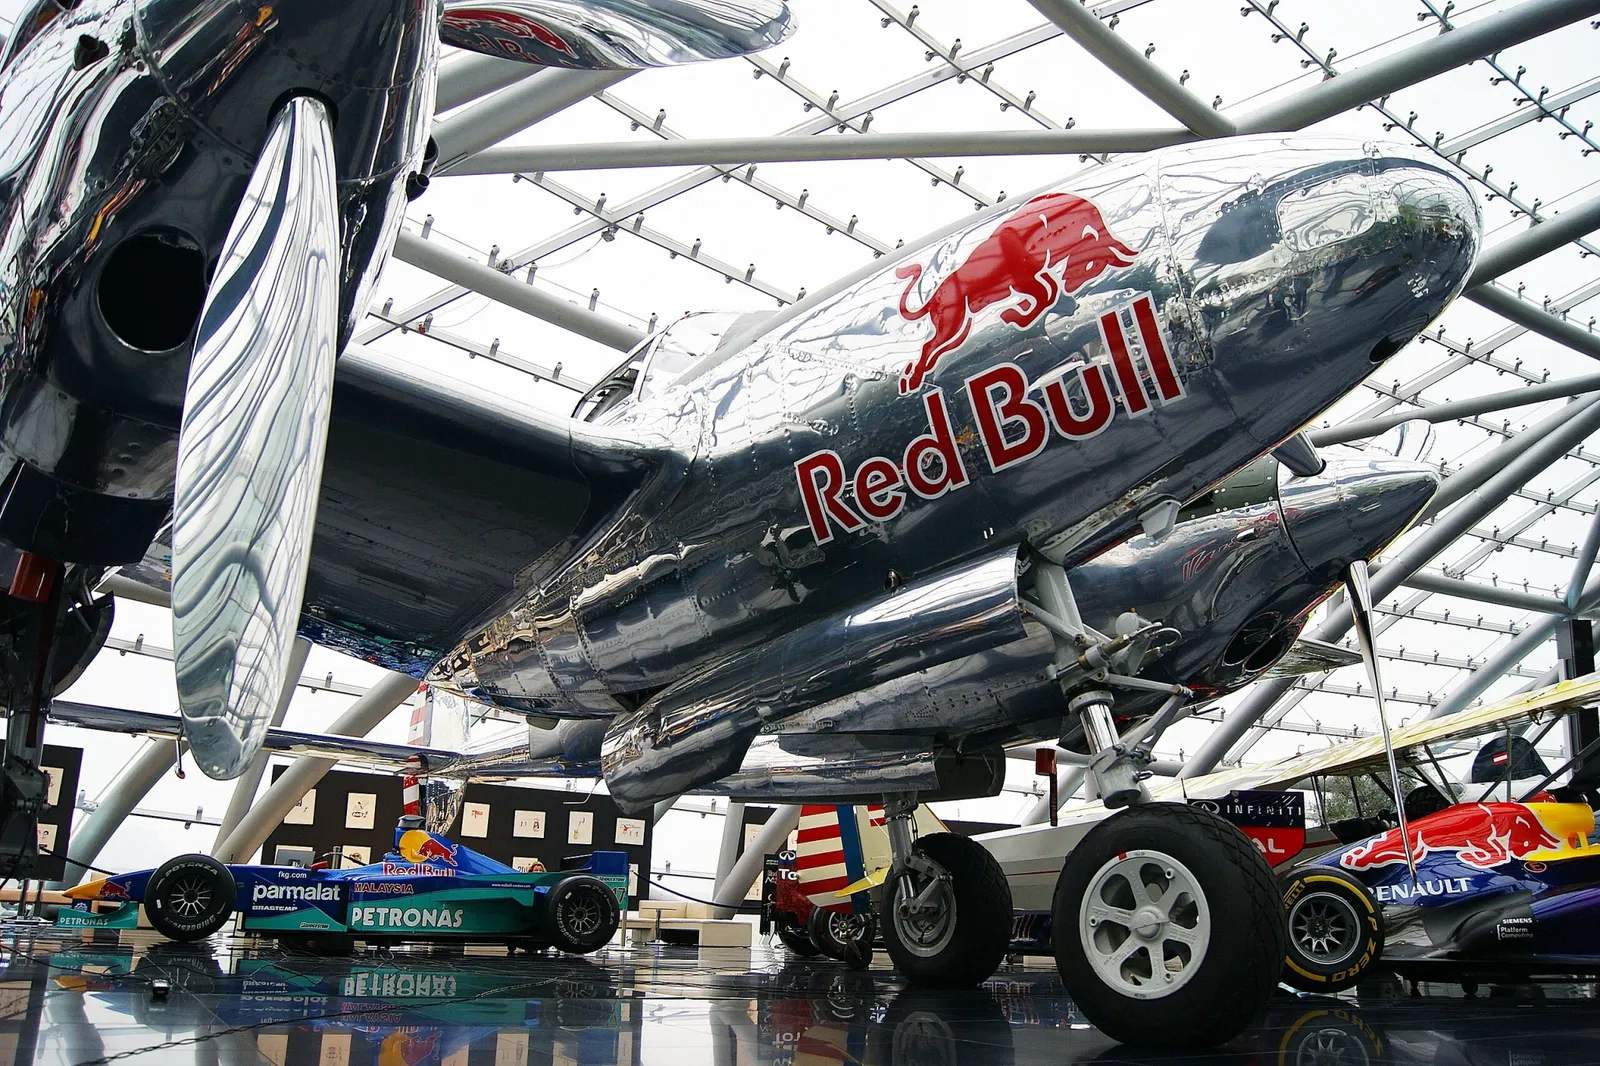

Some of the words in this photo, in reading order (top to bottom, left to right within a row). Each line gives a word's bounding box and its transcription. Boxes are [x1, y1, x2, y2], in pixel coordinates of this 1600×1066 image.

[795, 387, 970, 546] Red
[964, 290, 1187, 473] Bull
[1226, 804, 1302, 816] INFINITI
[278, 871, 307, 879] fkg.com
[253, 883, 341, 902] parmalat
[354, 883, 414, 894] MALAYSIA
[60, 917, 109, 926] PETRONAS
[352, 907, 463, 928] PETRONAS
[1367, 916, 1378, 931] P
[1331, 937, 1377, 983] ZERO
